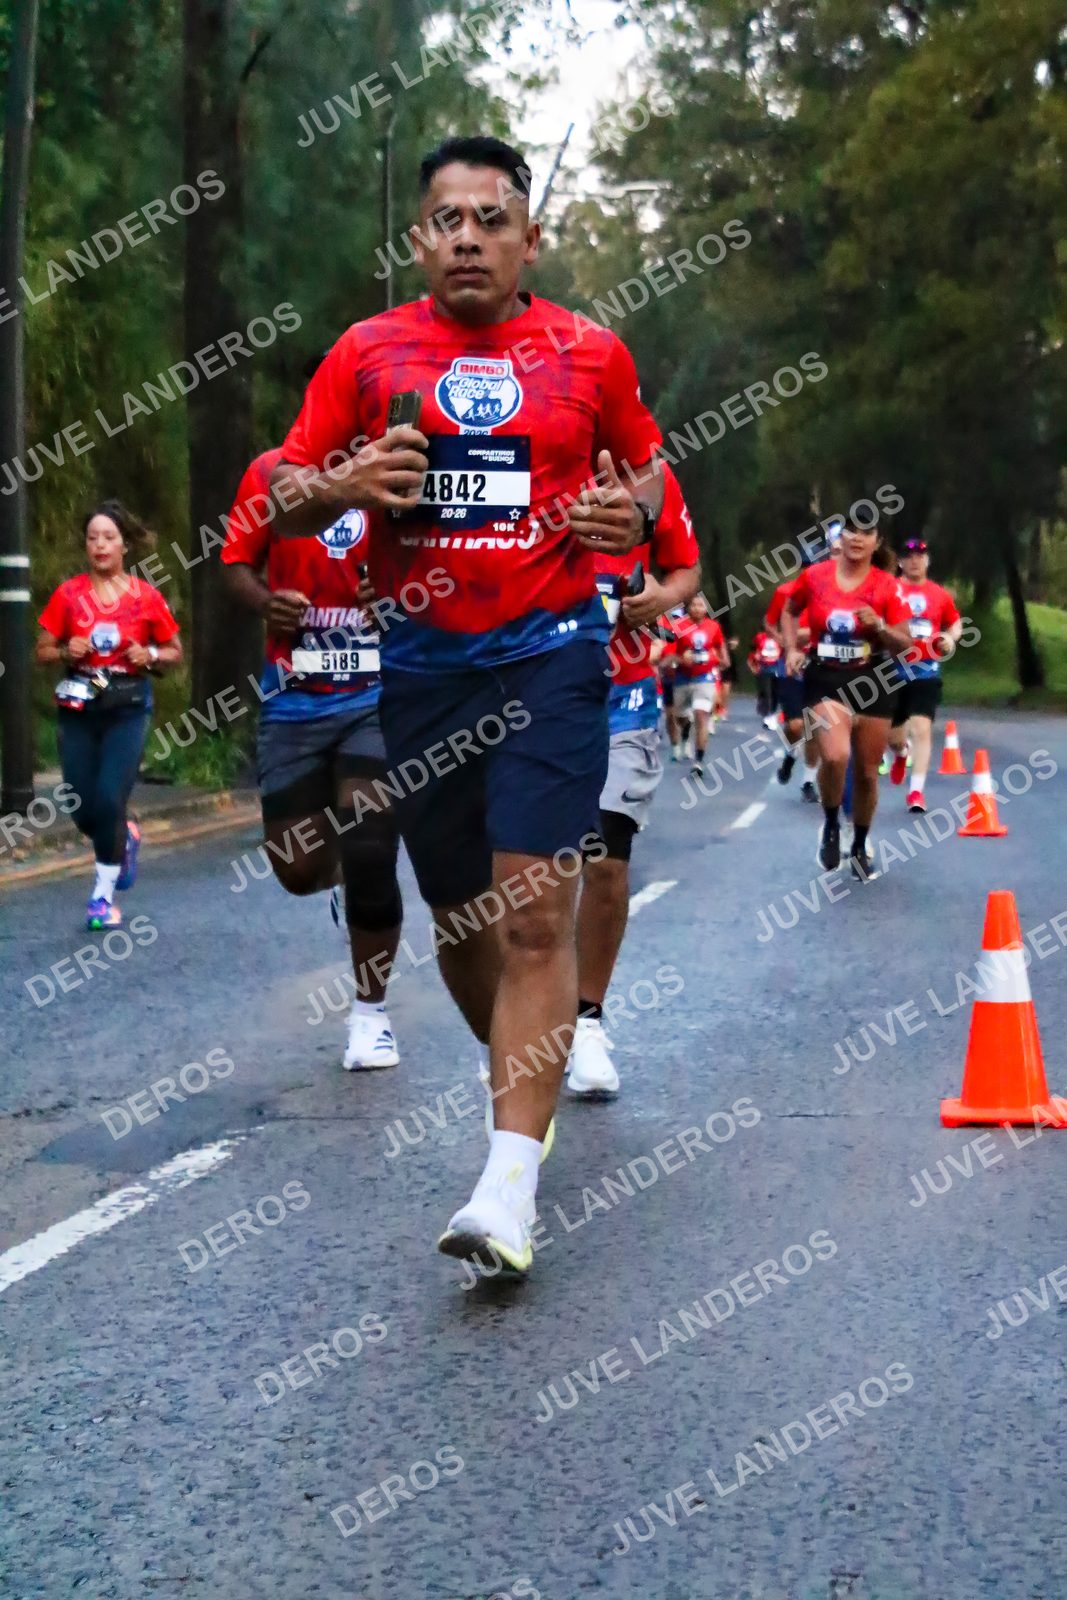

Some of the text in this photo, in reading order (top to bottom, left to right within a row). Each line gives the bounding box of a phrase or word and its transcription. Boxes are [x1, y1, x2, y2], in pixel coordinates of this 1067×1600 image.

[460, 364, 504, 375] BIMBO
[458, 377, 502, 391] Global
[448, 384, 485, 399] Race
[423, 473, 486, 502] 4842
[441, 508, 467, 519] 20-26
[493, 522, 515, 532] 10K
[321, 652, 360, 671] 5189
